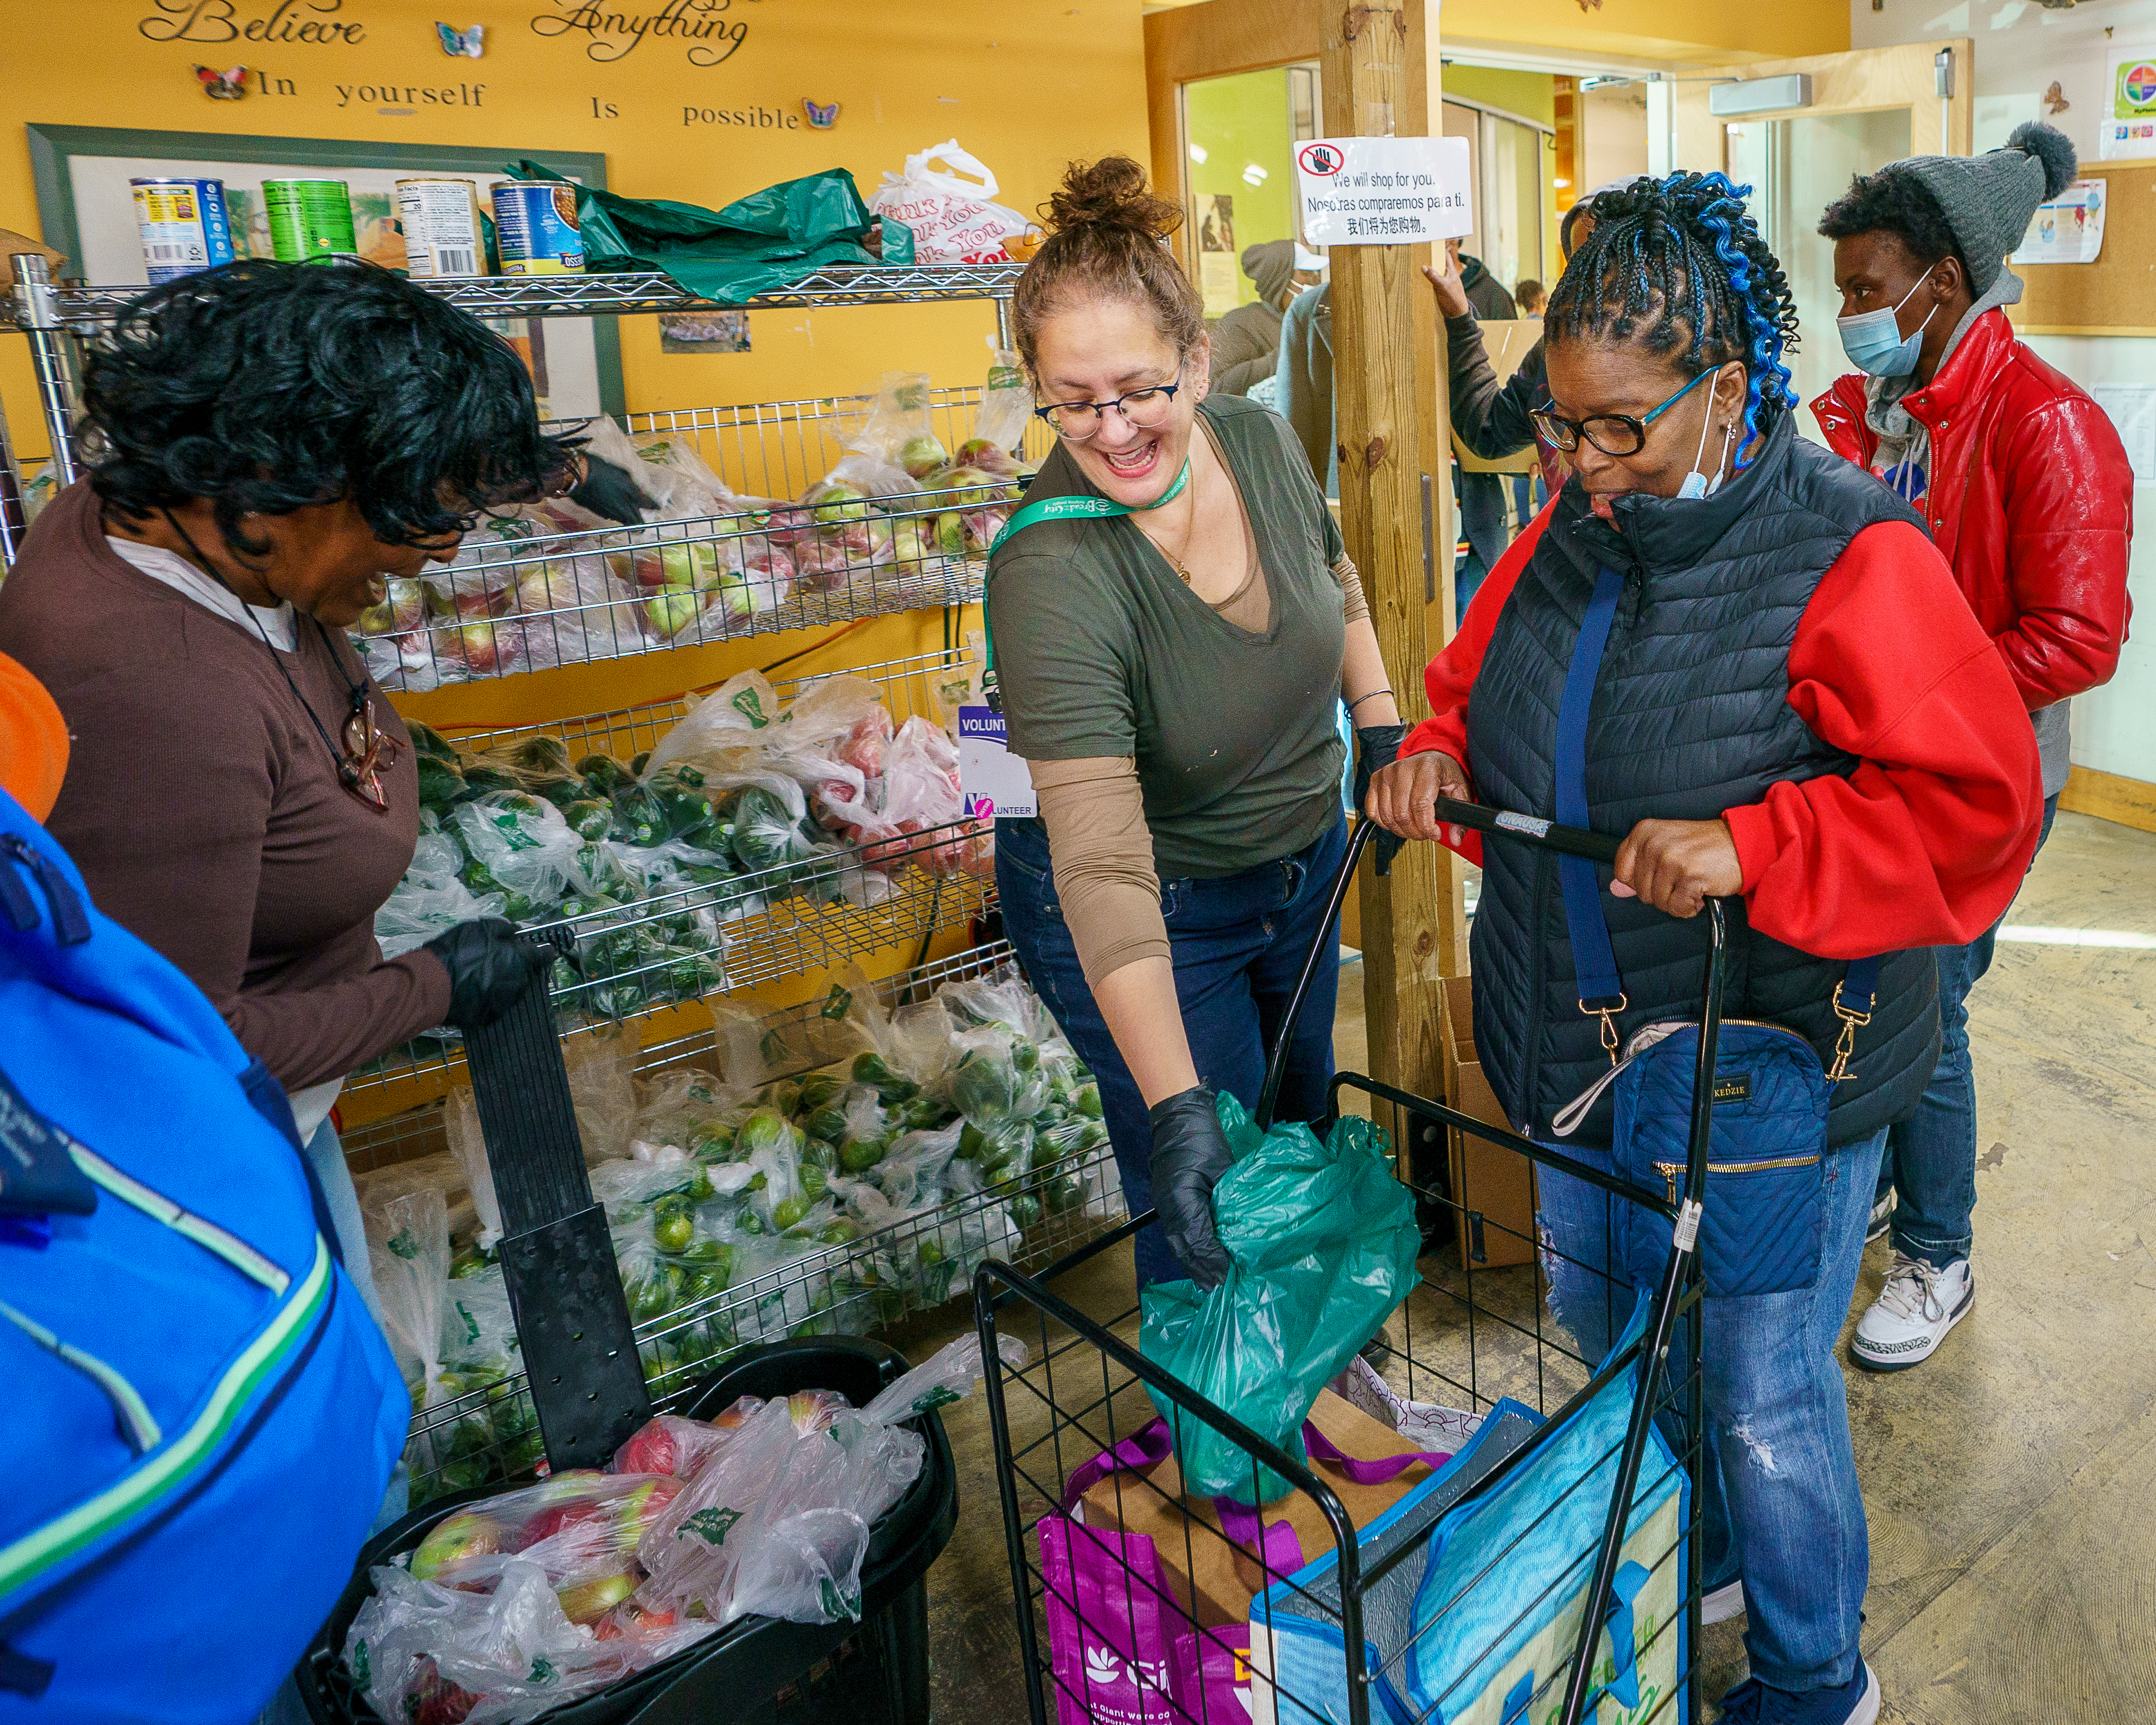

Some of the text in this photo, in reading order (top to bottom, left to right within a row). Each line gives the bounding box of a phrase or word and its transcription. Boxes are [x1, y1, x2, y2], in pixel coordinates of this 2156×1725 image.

[139, 0, 368, 45] Believe
[531, 0, 749, 67] Anything
[256, 70, 486, 107] In yourself
[591, 98, 799, 130] Is possible
[1331, 171, 1435, 191] We will shop for you.
[1358, 197, 1424, 213] compraremos
[1455, 192, 1464, 207] ti.
[948, 221, 1005, 253] You
[1347, 216, 1426, 236] 我们将为您购物。
[1714, 1086, 1745, 1098] KEDZIE
[1100, 1704, 1125, 1718] Giant
